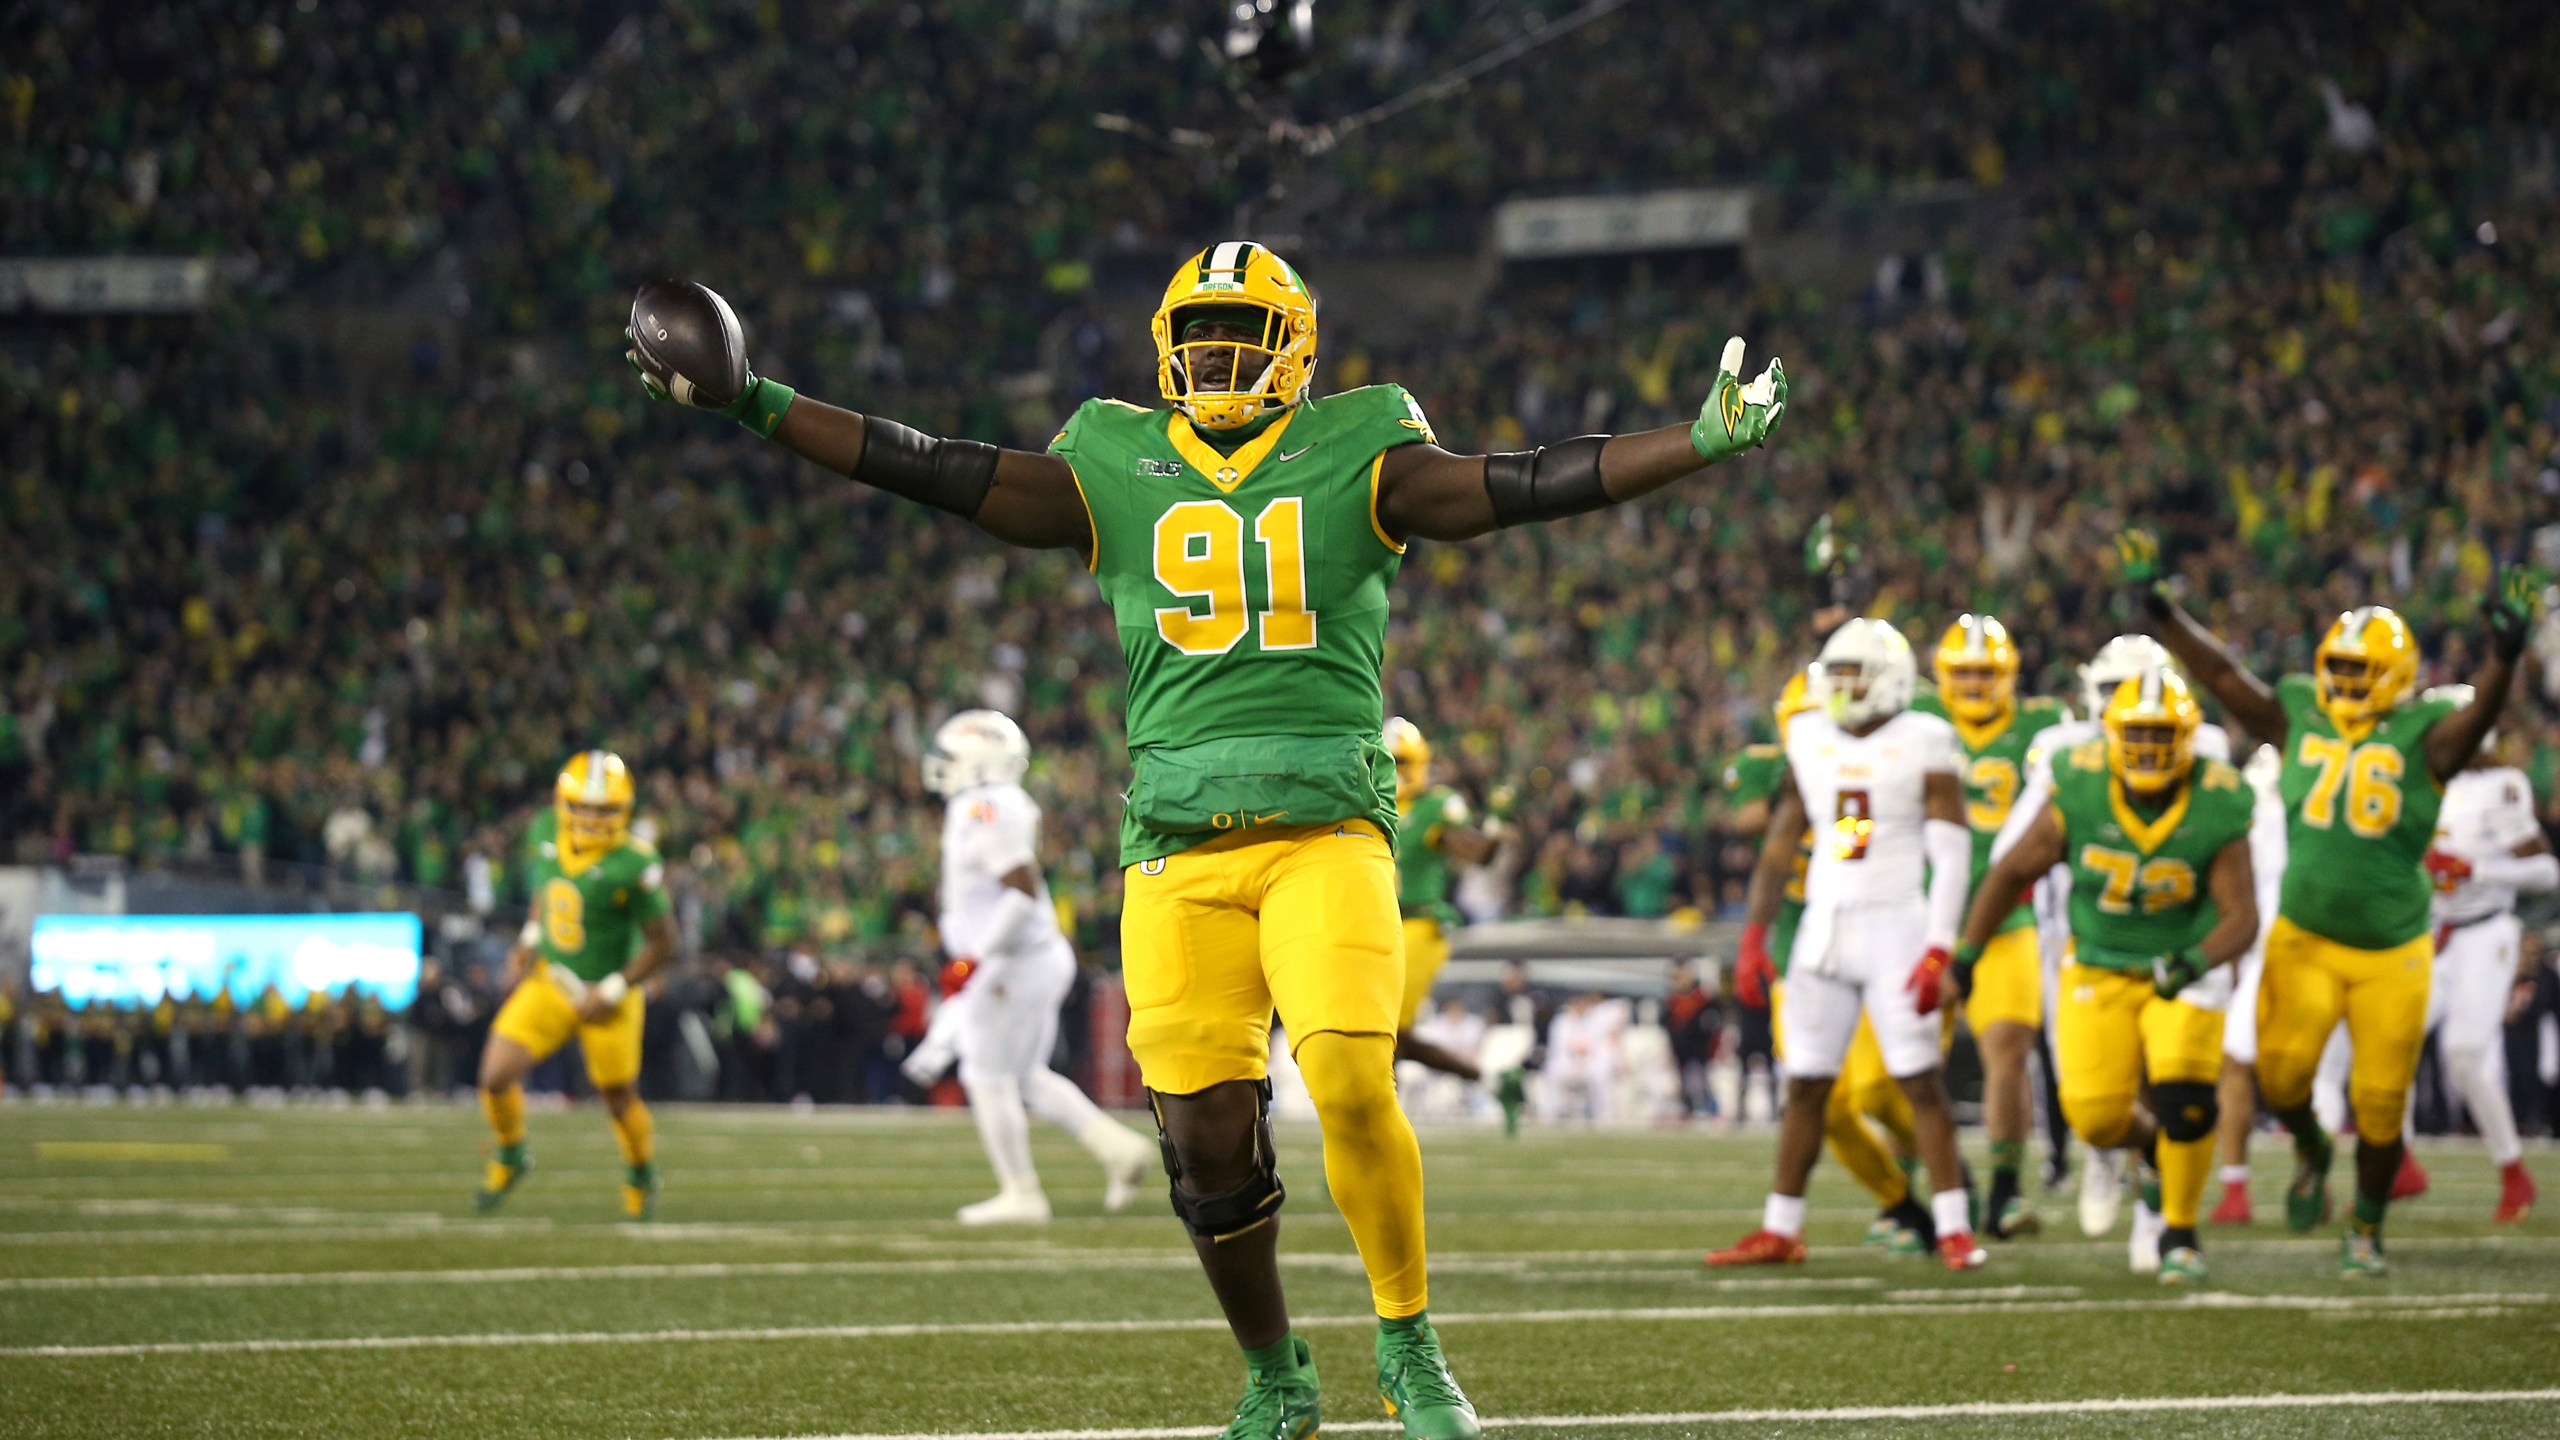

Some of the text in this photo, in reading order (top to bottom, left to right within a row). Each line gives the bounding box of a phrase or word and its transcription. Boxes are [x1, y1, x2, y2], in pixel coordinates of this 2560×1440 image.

[1203, 282, 1234, 291] OREGON
[1154, 496, 1318, 655] 91
[2299, 732, 2404, 838] 76
[544, 878, 586, 954] 8
[2081, 843, 2197, 915] 72
